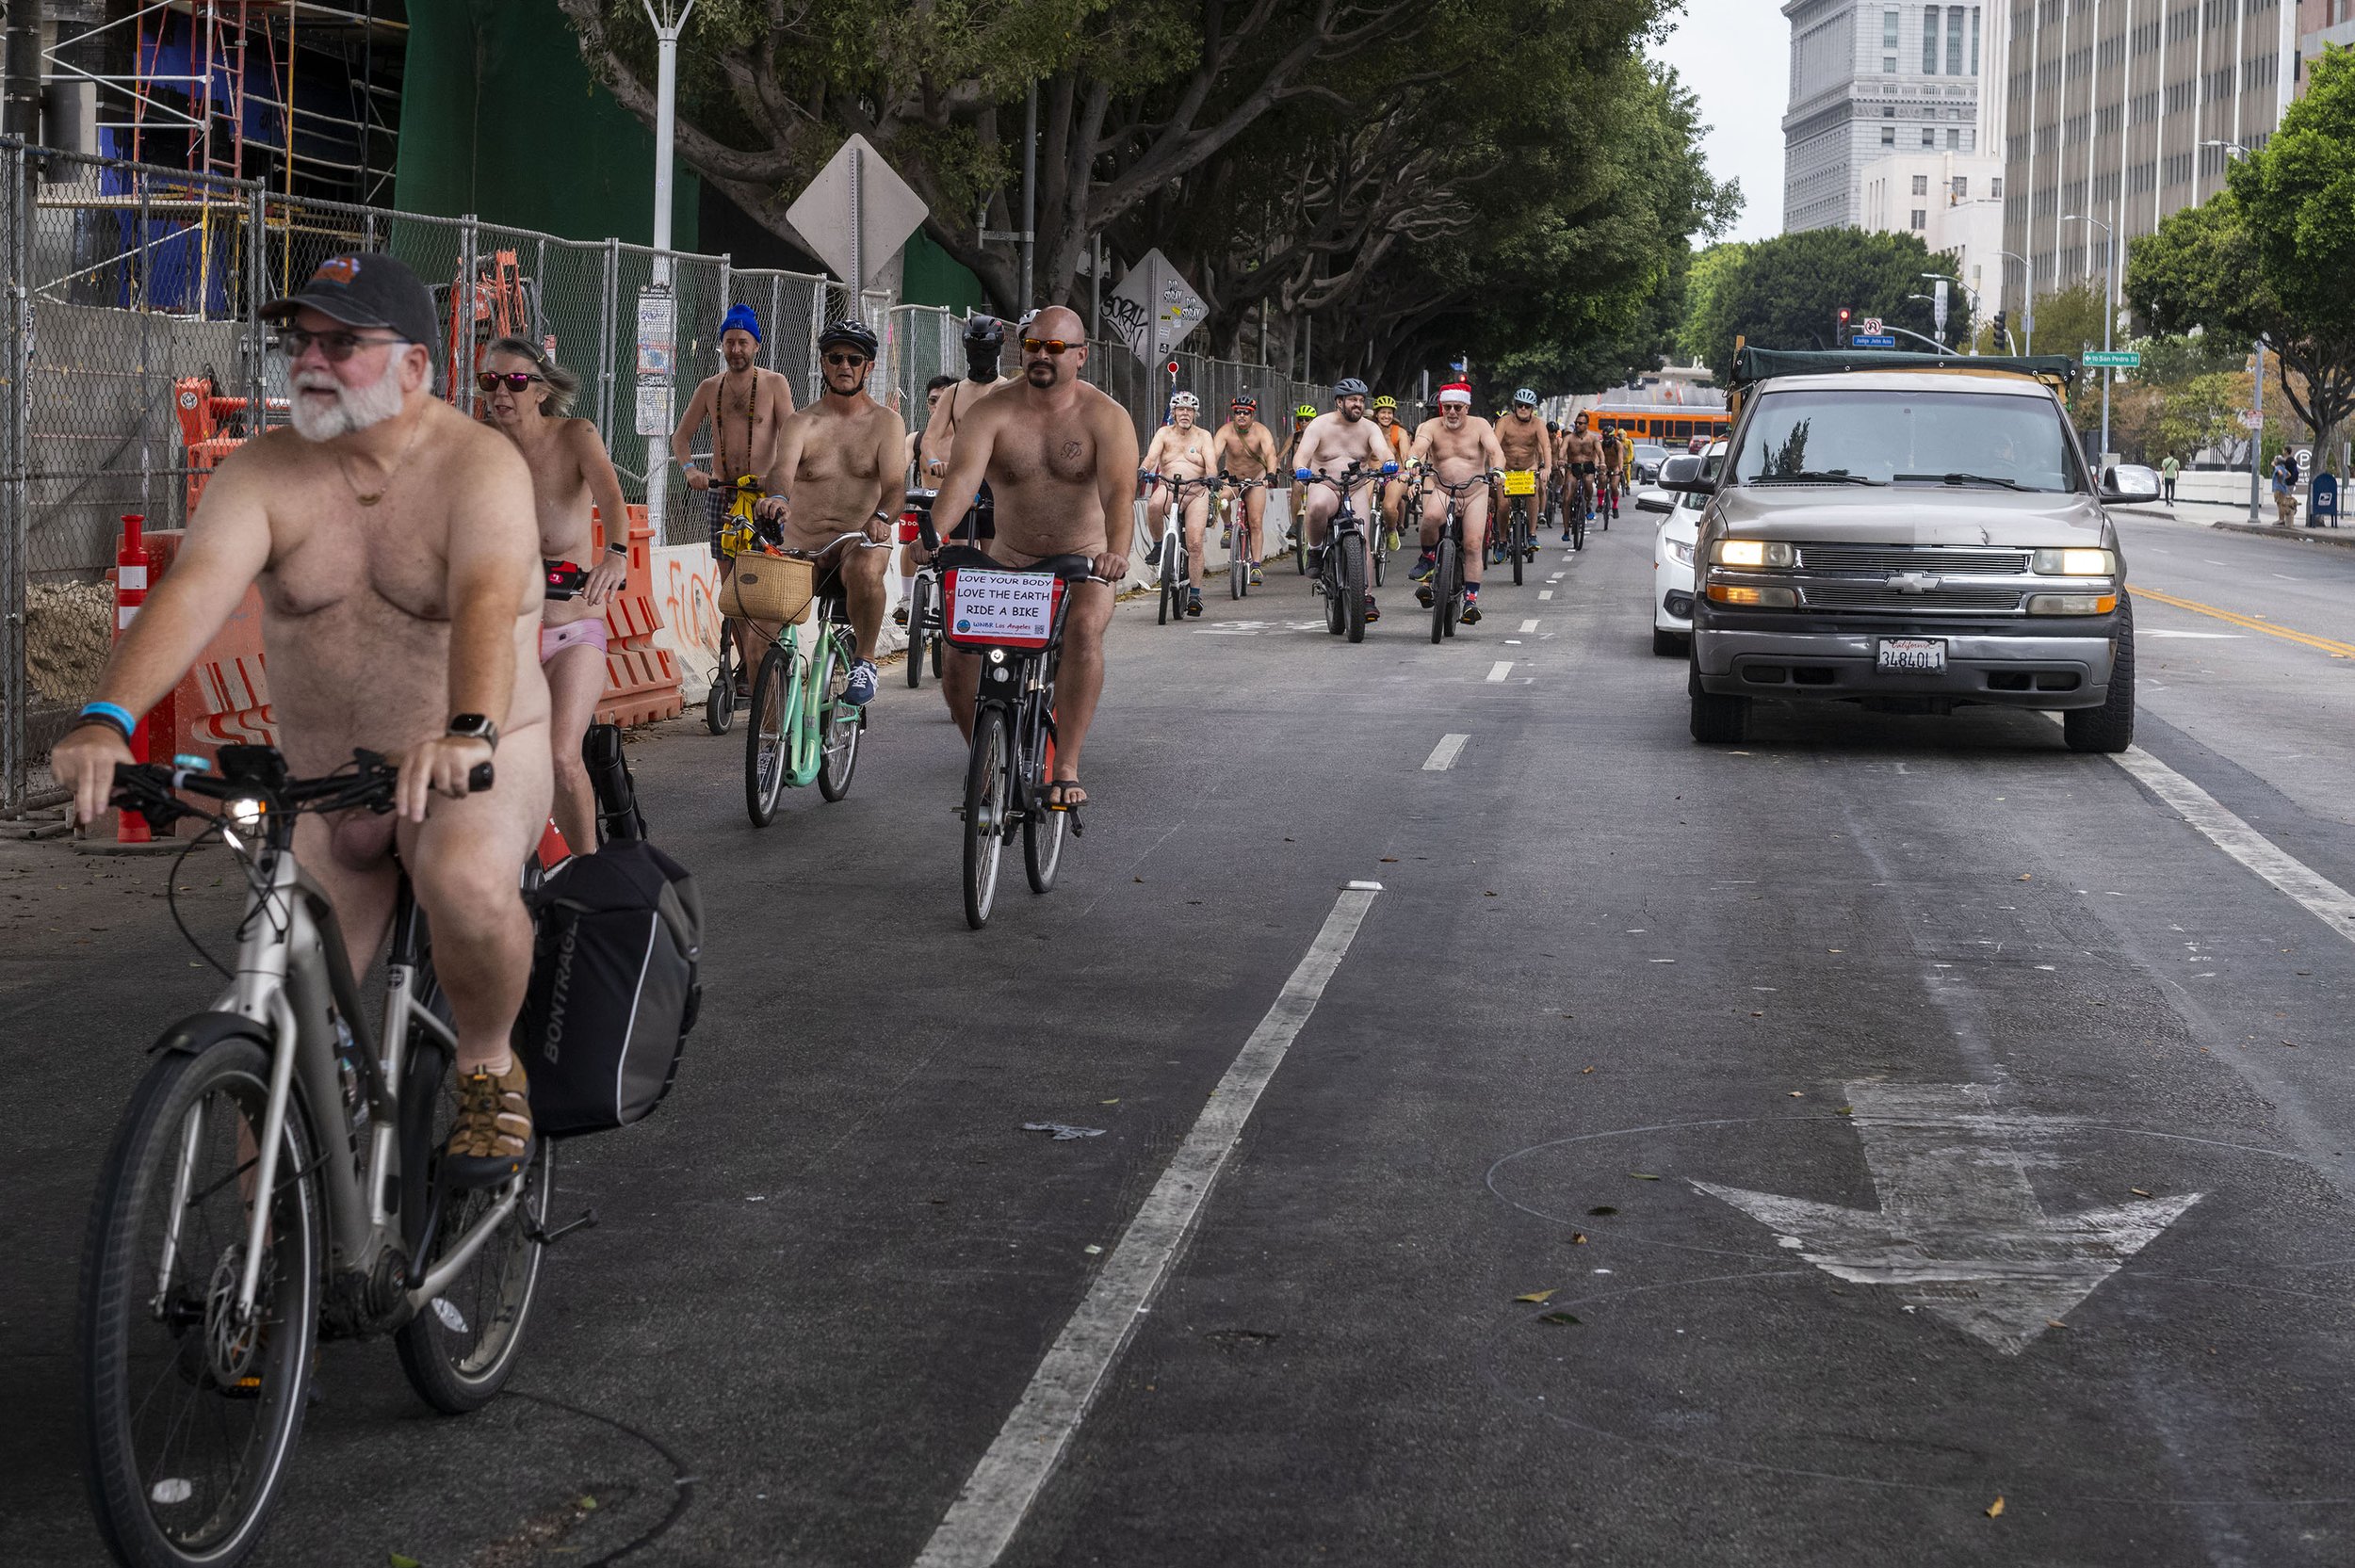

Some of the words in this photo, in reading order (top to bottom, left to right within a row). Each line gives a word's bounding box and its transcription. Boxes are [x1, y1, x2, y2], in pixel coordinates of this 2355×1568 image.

[958, 575, 986, 584] LOVE
[990, 576, 1019, 586] YOUR
[1022, 578, 1052, 587] BODY
[957, 588, 986, 599] LOVE
[989, 590, 1010, 600] THE
[1014, 590, 1050, 602] EARTH
[966, 605, 995, 616] RIDE
[999, 606, 1007, 616] A
[1012, 606, 1039, 618] BIKE
[1007, 623, 1031, 632] Angeles
[1891, 640, 1930, 651] California
